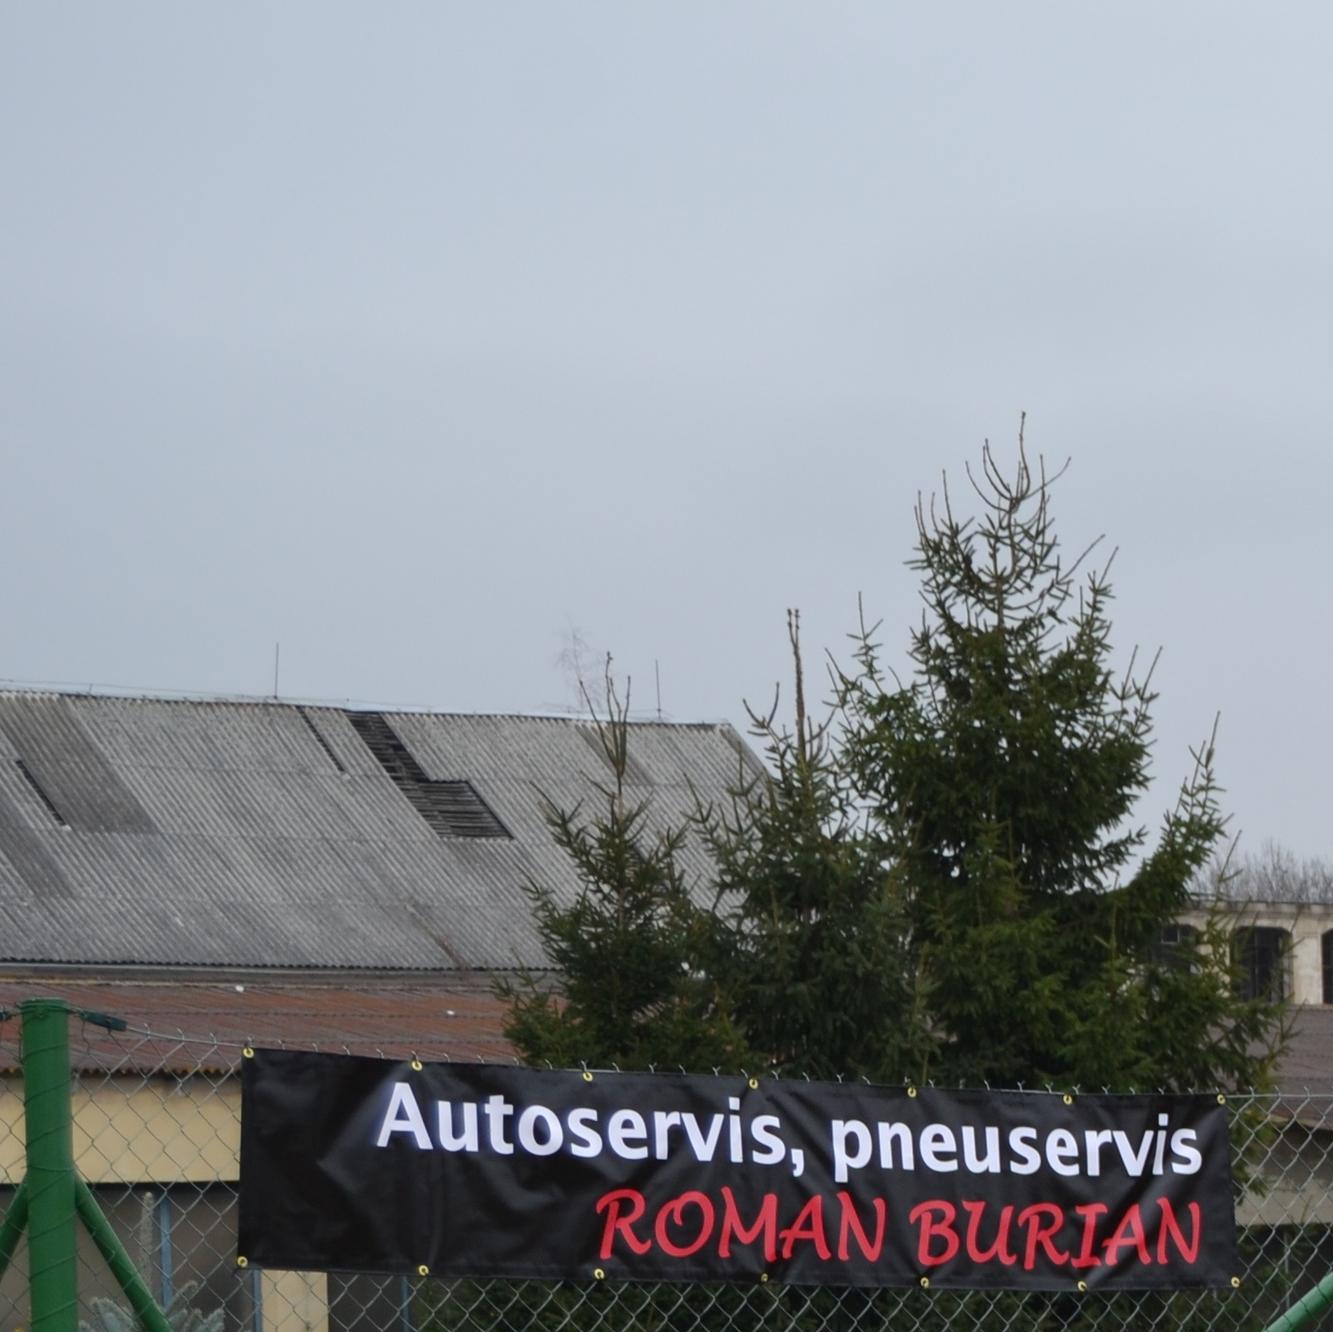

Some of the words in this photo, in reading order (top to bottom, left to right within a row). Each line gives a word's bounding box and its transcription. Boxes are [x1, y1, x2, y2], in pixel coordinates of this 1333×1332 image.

[376, 1081, 806, 1178] Autoservis,
[831, 1112, 1203, 1184] pneuservis
[596, 1186, 888, 1263] ROMAN
[908, 1196, 1201, 1271] BURIAN
